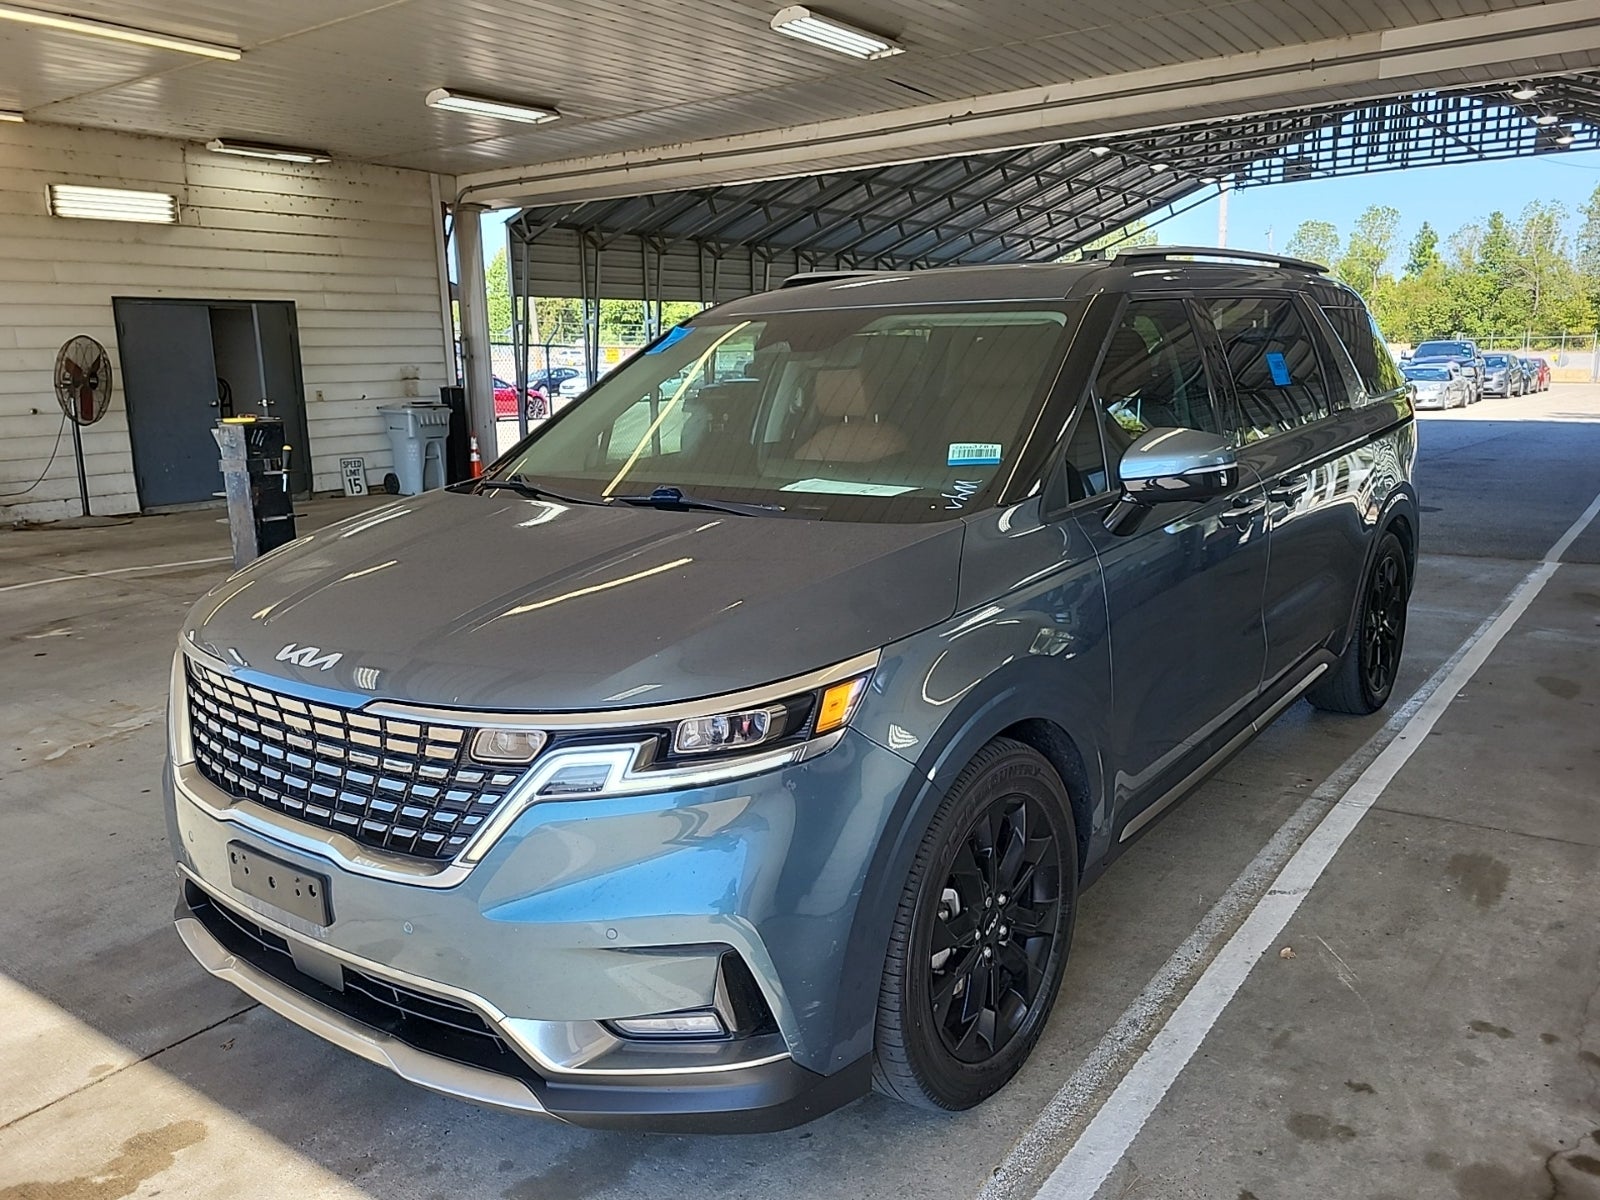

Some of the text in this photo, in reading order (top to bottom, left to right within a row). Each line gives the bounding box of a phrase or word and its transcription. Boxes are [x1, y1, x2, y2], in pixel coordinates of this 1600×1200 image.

[343, 460, 361, 468] SPEED
[345, 469, 360, 477] LIMIT
[348, 478, 363, 494] 15
